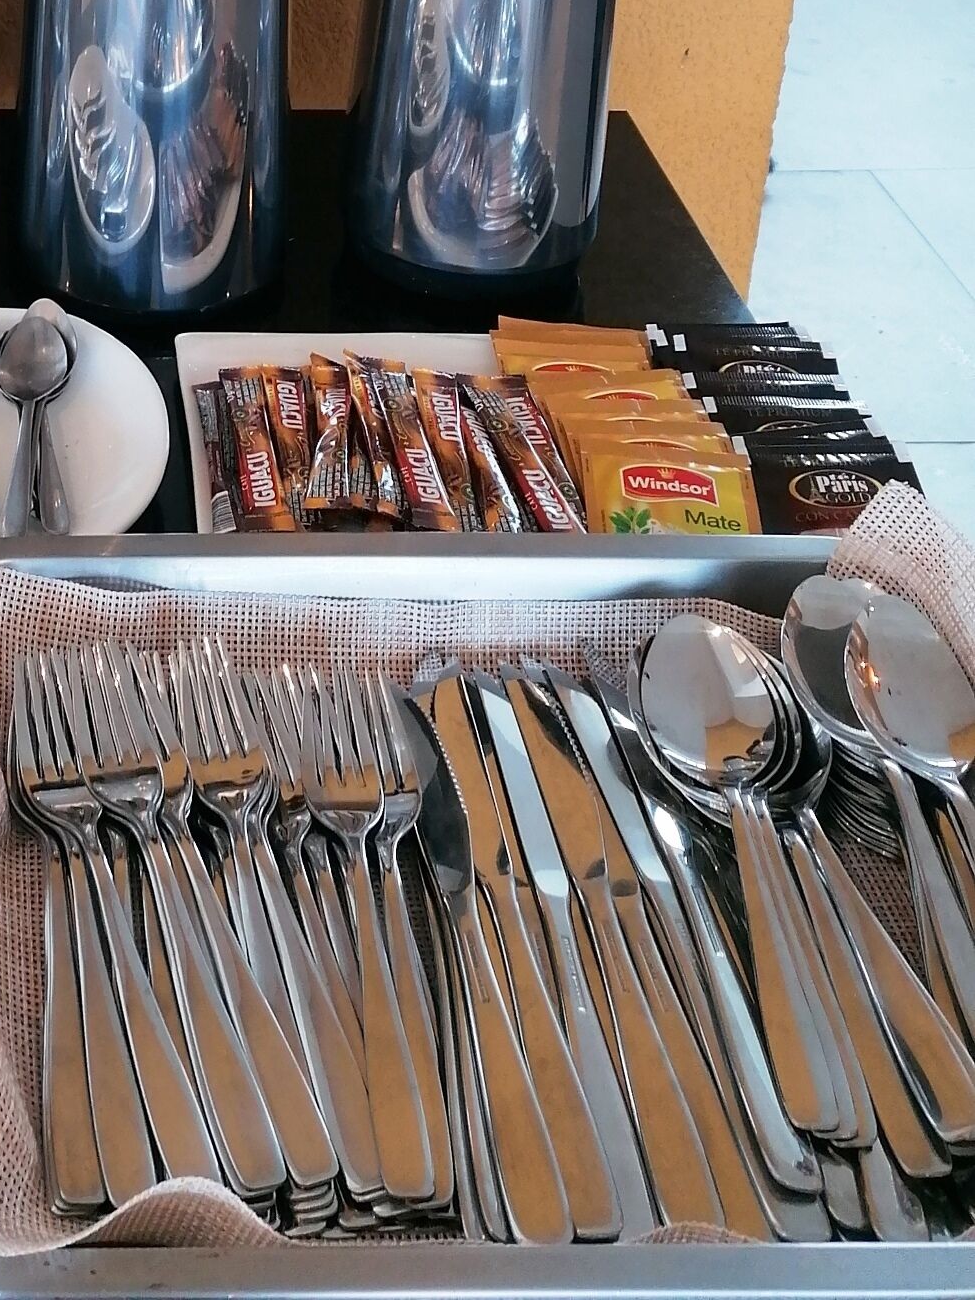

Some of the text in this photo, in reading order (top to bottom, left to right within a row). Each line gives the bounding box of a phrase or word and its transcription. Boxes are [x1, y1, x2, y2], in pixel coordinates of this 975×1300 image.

[627, 475, 711, 496] Windsor
[815, 474, 869, 493] Paris
[826, 492, 872, 504] GOLD
[684, 509, 742, 532] Mate
